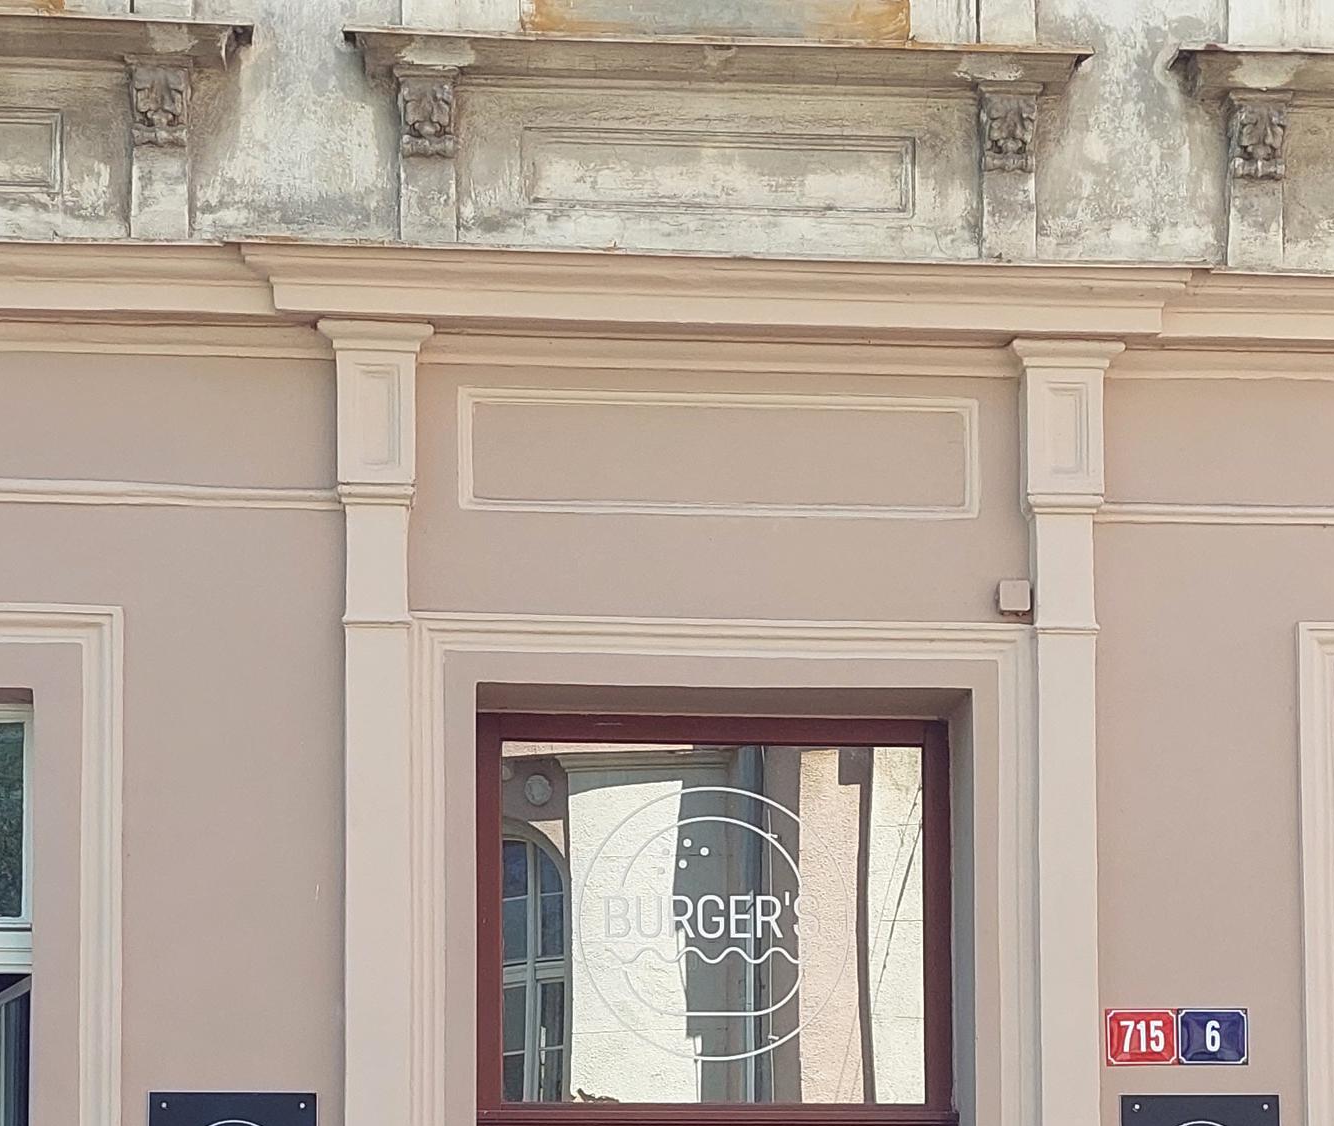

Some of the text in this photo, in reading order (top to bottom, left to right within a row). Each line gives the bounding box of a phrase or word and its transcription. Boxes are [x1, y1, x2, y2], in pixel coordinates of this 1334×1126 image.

[603, 891, 820, 939] BURGER'S
[1120, 1020, 1166, 1053] 715
[1204, 1020, 1221, 1053] 6
